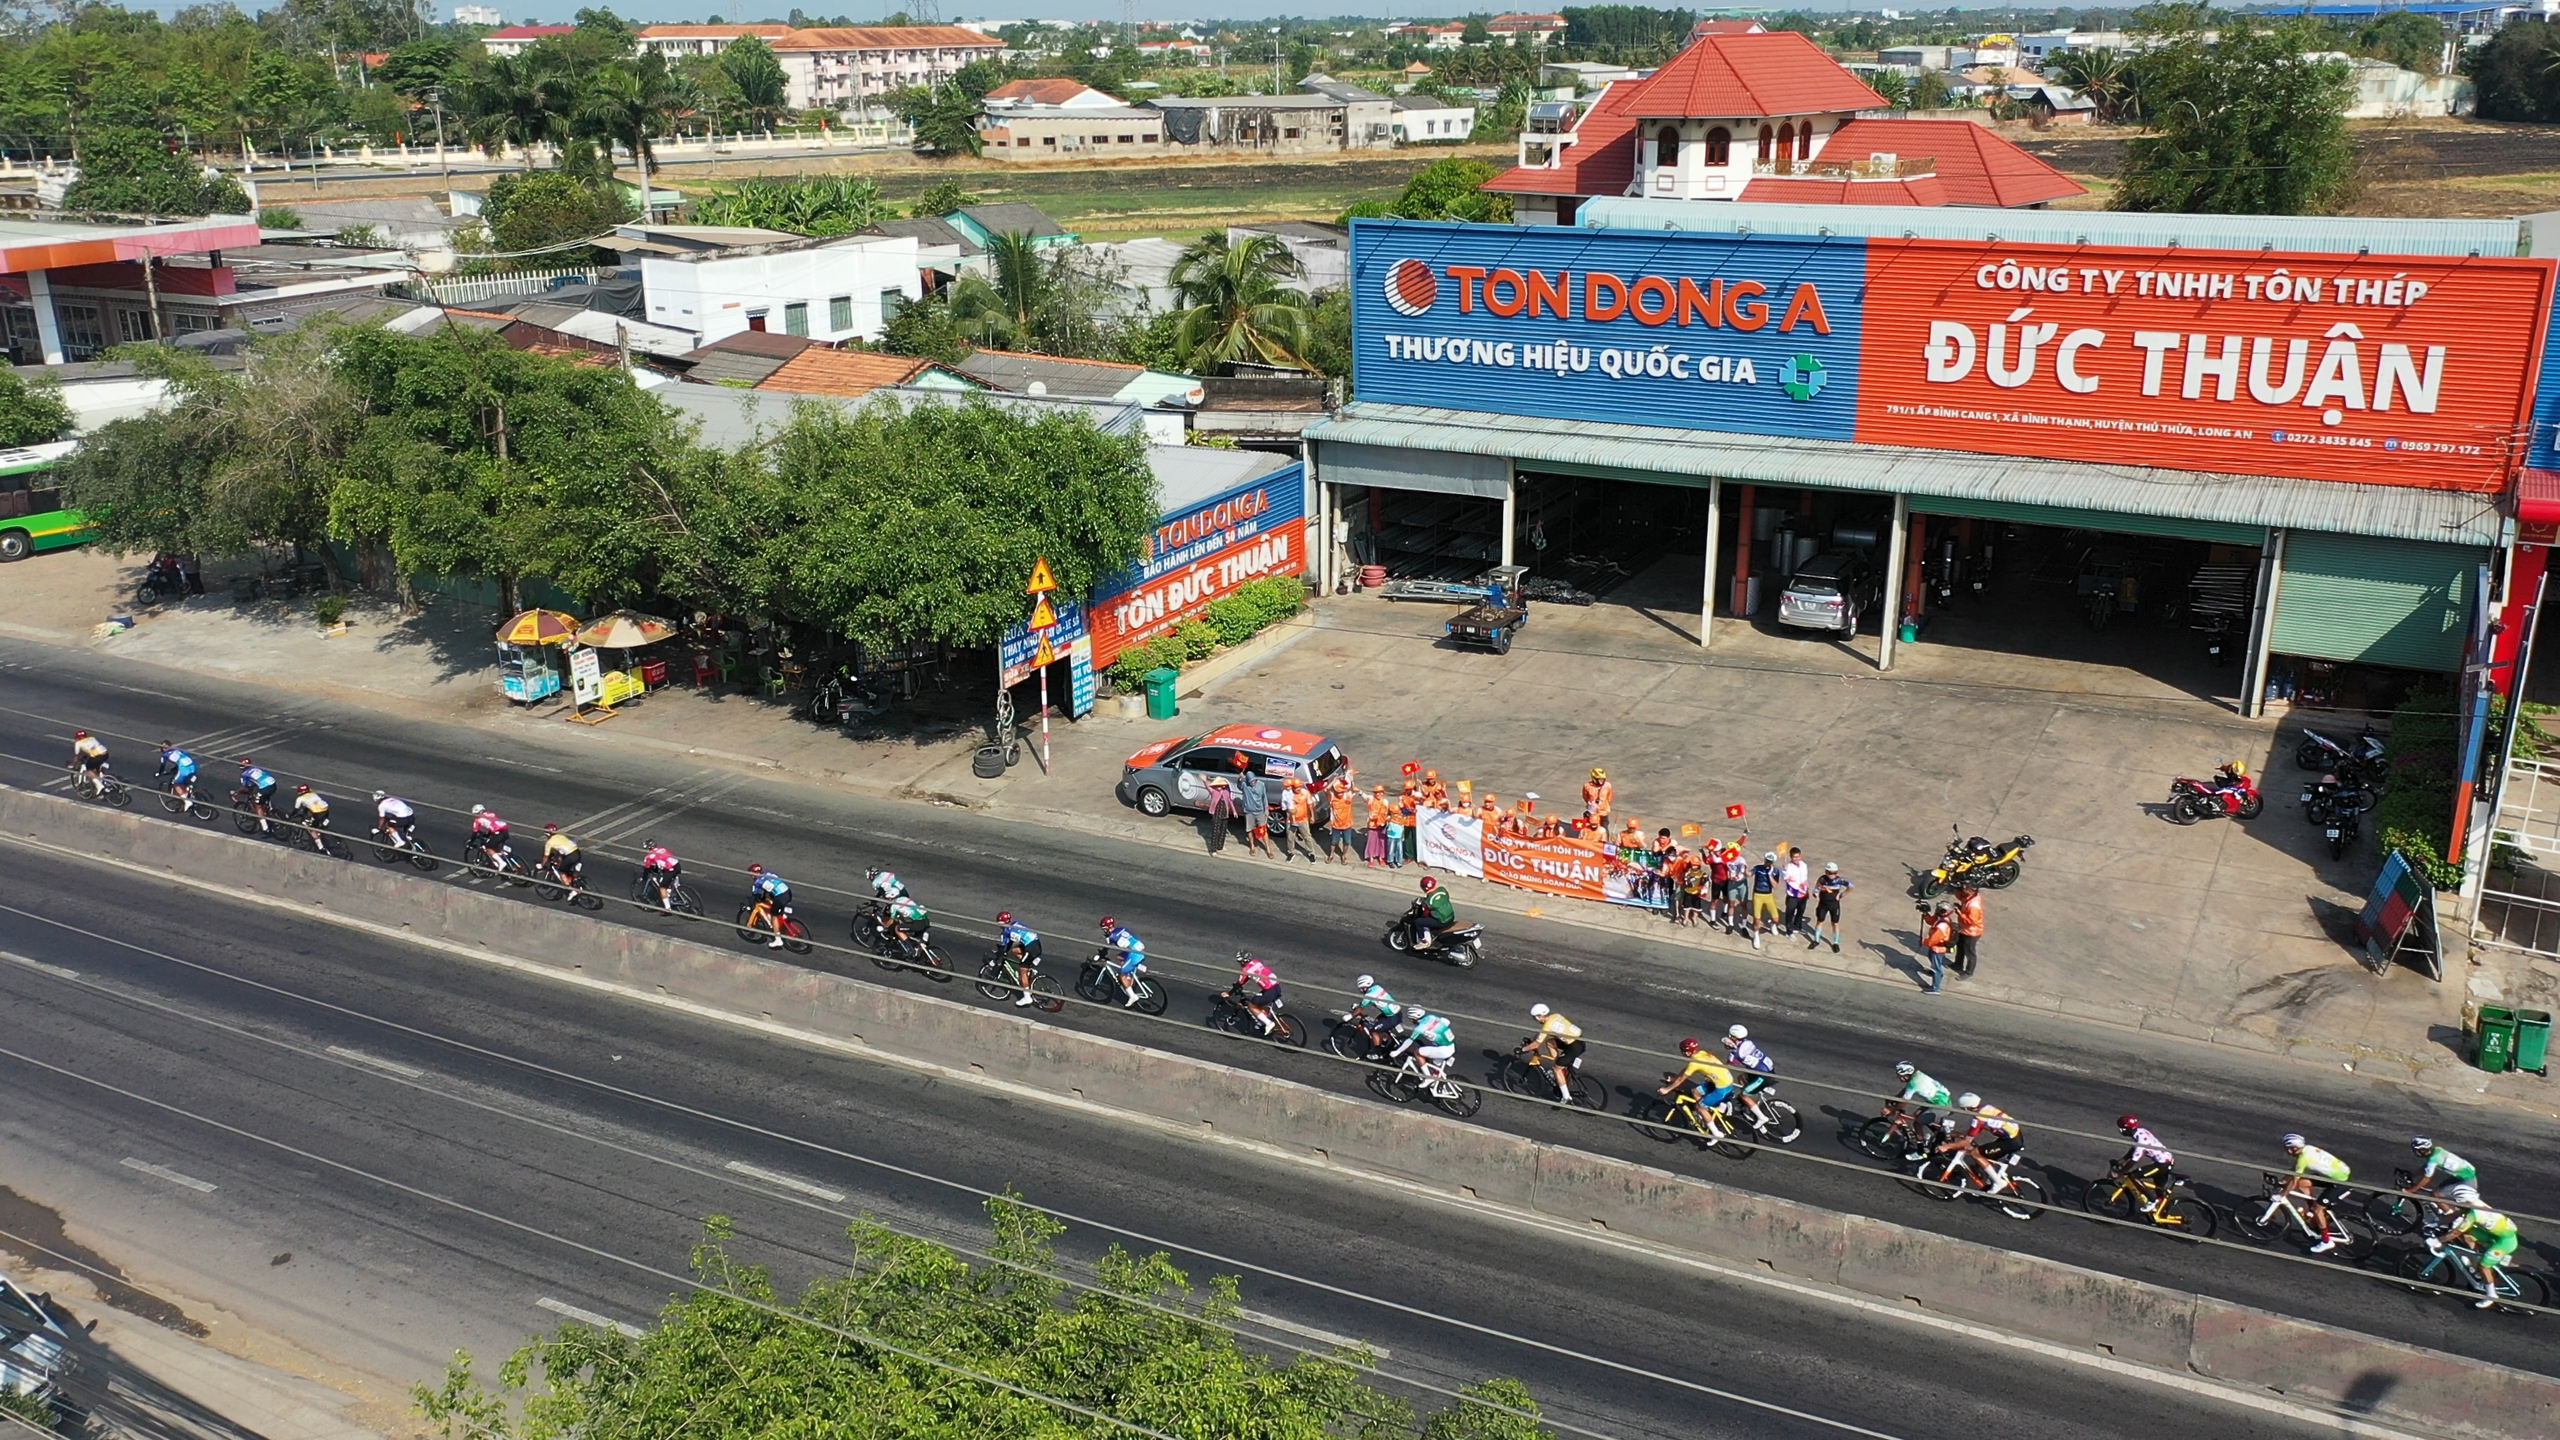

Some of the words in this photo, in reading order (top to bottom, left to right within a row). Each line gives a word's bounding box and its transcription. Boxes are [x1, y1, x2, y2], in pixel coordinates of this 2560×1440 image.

[1446, 265, 1570, 319] TON
[1584, 271, 1769, 332] DONG
[1779, 282, 1831, 334] A
[1977, 258, 2070, 292] CÔNG
[2080, 269, 2124, 295] TY
[2135, 271, 2234, 300] TNHH
[2244, 268, 2322, 303] TÔN
[2333, 273, 2428, 307] THÉP
[1385, 334, 1515, 367] THƯƠNG
[1523, 339, 1590, 378] HIỆU
[1599, 345, 1690, 380] QUỐC
[1699, 356, 1757, 385] GIA
[1924, 307, 2106, 393] ĐỨC
[2133, 322, 2446, 426] THUẬN
[1886, 405, 1915, 415] 791/1
[1917, 405, 1931, 416] ẤP
[1933, 406, 1959, 418] BÌNH
[2002, 412, 2019, 422] XÃ
[2022, 413, 2048, 424] BÌNH
[2050, 416, 2092, 429] THẠNH,
[2094, 419, 2133, 432] HUYỆN
[2136, 421, 2158, 432] THỦ
[2199, 427, 2231, 437] LONG
[2234, 430, 2252, 439] AN
[2287, 433, 2316, 444] 0272
[2318, 435, 2347, 446] 3835
[2349, 437, 2372, 447] 845
[2401, 441, 2431, 451] 0969
[2433, 442, 2455, 453] 797
[2458, 444, 2480, 455] 172
[1156, 514, 1200, 554] TON
[1200, 493, 1255, 536] DONG
[1254, 489, 1270, 515] A
[1143, 561, 1161, 579] BẢO
[1164, 549, 1188, 571] HÀNH
[1190, 541, 1206, 559] LÊN
[1206, 532, 1223, 552] ĐẾN
[1225, 530, 1236, 545] 50
[1238, 520, 1258, 540] NĂM
[1114, 589, 1165, 635] TÔN
[1168, 563, 1214, 611] ĐỨC
[1218, 532, 1288, 588] THUẬN
[1003, 640, 1022, 659] THAY
[1241, 739, 1282, 750] DONG
[1425, 840, 1444, 851] TON
[1552, 845, 1572, 856] TÔN
[1573, 848, 1595, 858] THÉP
[1484, 847, 1526, 870] ĐỨC
[1530, 858, 1600, 885] THUẬN
